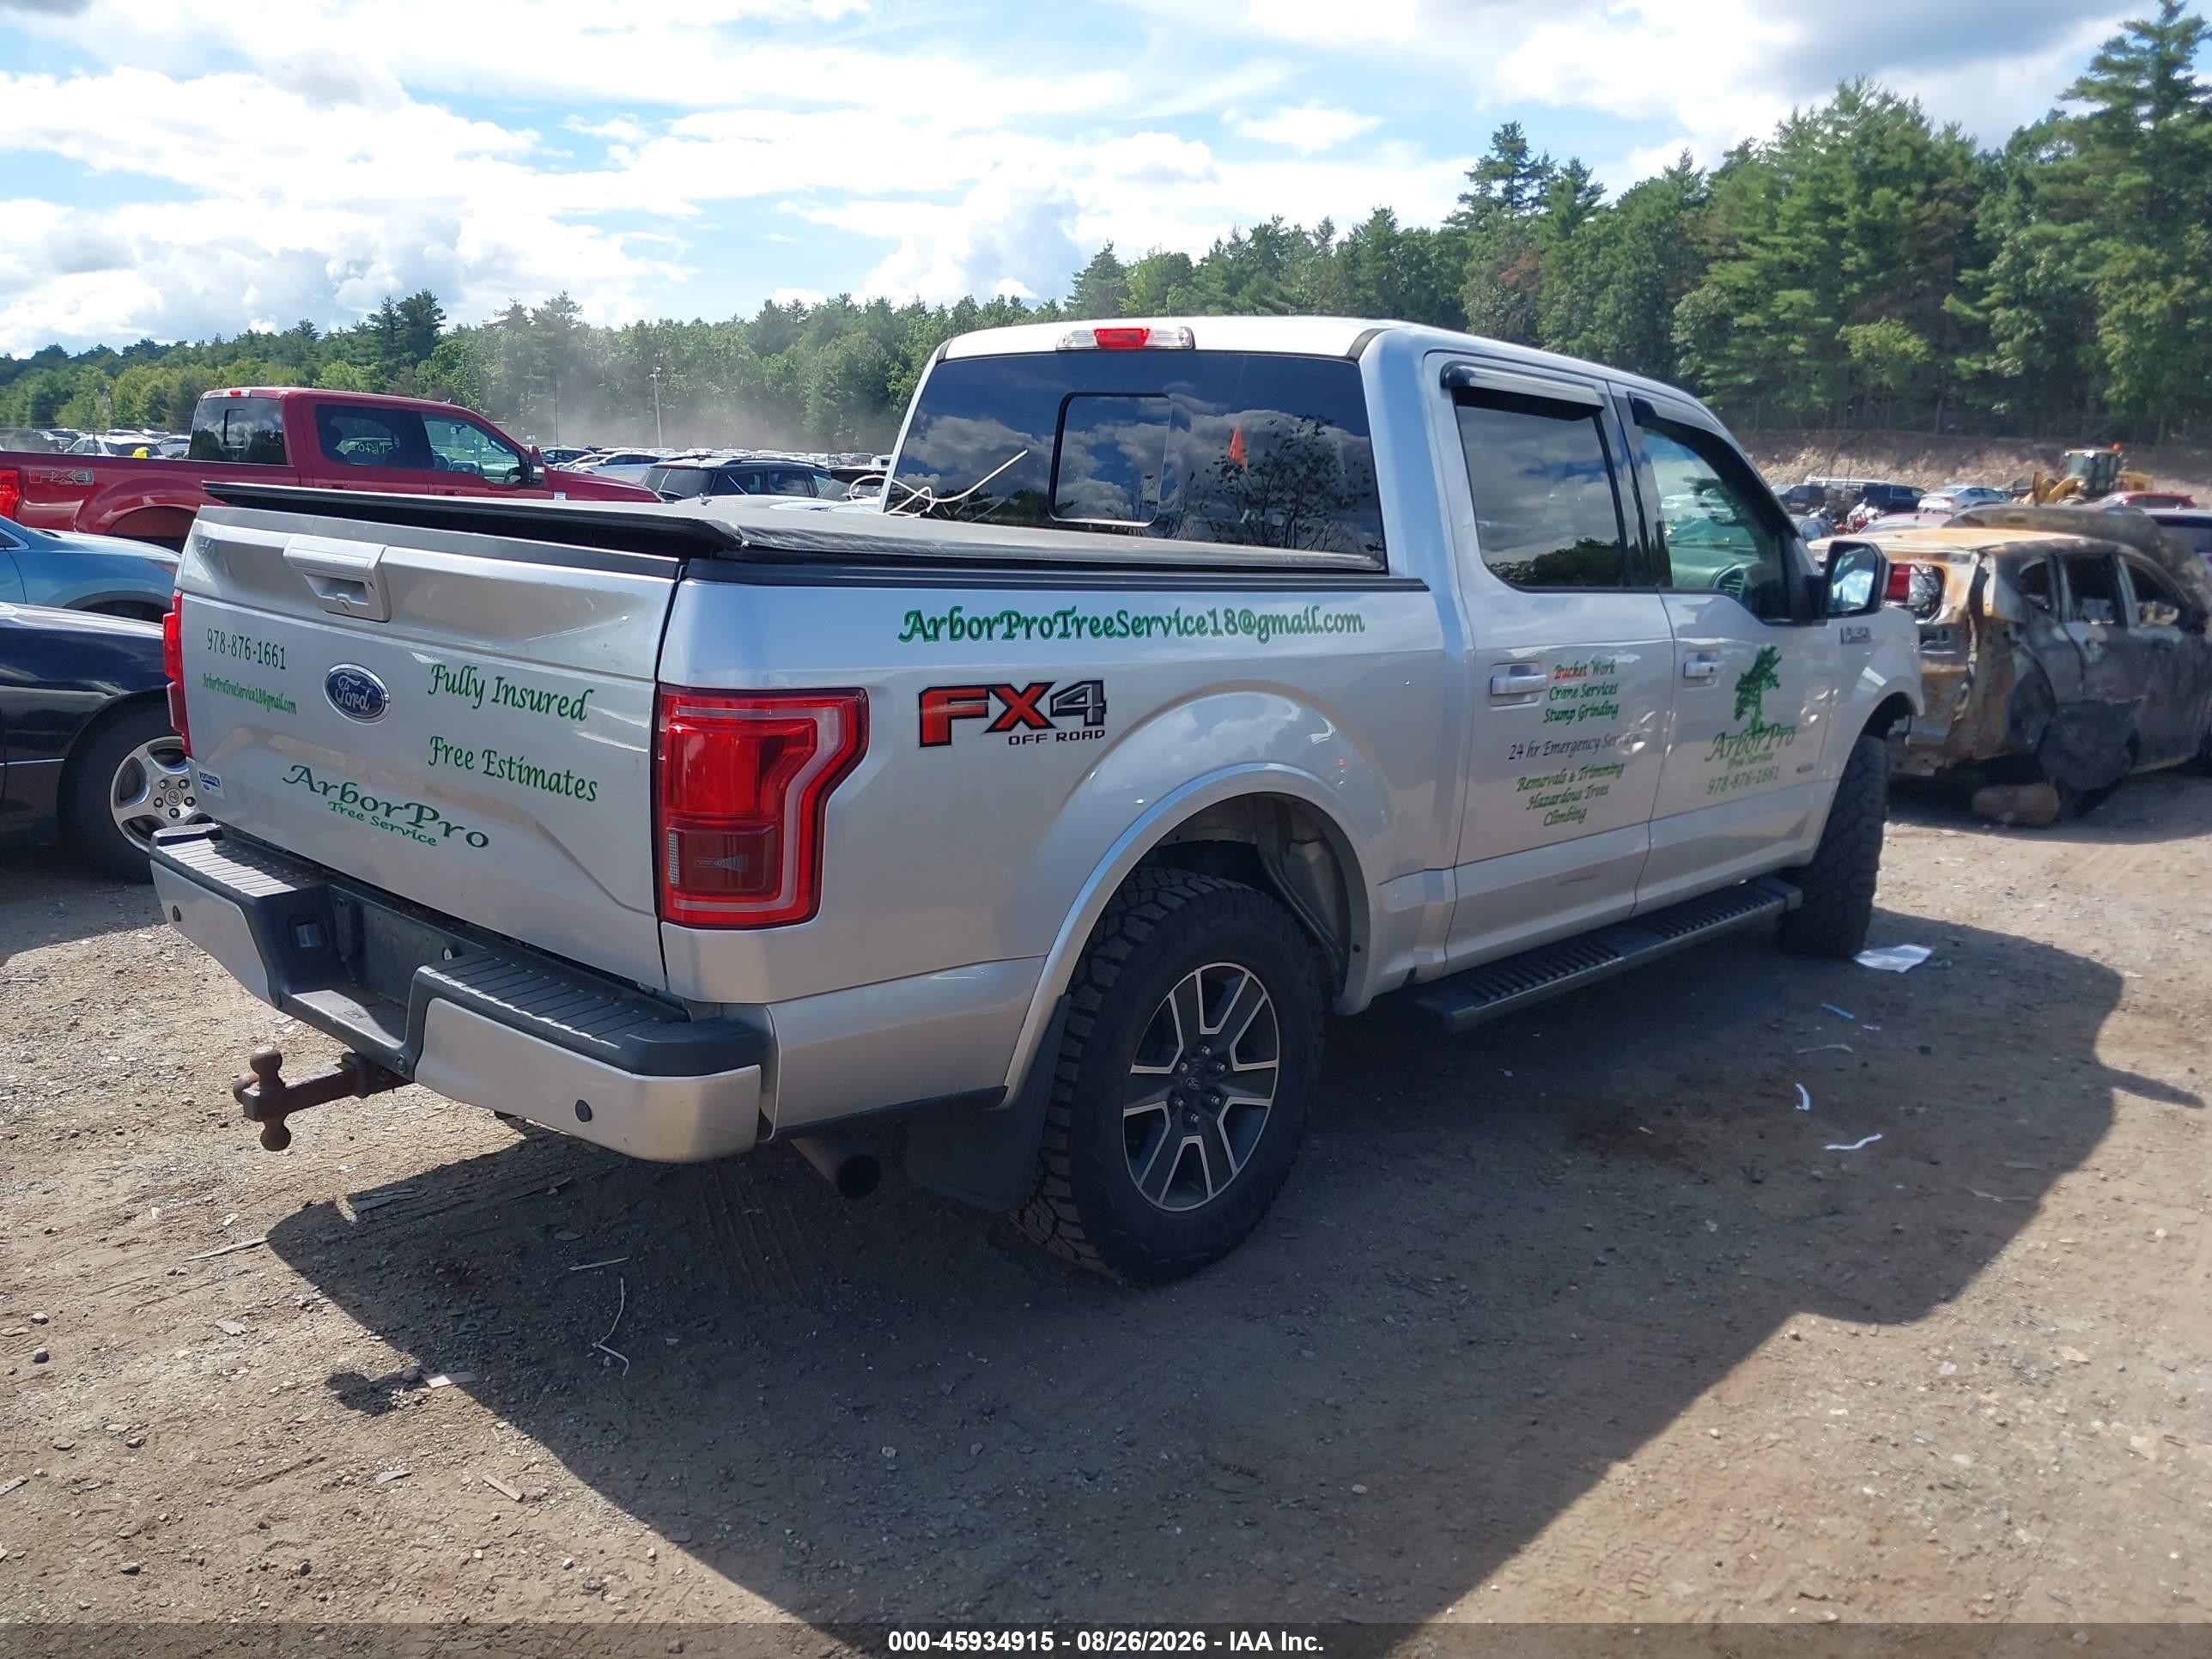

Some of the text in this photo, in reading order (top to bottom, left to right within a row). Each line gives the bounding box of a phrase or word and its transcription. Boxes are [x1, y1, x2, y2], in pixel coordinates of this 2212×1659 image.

[898, 605, 1365, 644] ArborProTreeService18@gmail.com
[207, 628, 286, 670] 978-876-1661
[1553, 659, 1616, 679] Bucket Work
[335, 675, 370, 712] Ford
[428, 664, 595, 720] Fully Insured
[1549, 681, 1619, 701] Crane Services
[918, 680, 1107, 748] FX4
[1543, 700, 1620, 726] Stump Grinding
[1008, 728, 1106, 745] OFF ROAD
[1508, 744, 1523, 760] 24
[1526, 741, 1540, 757] hr
[1543, 737, 1601, 758] Emergency
[1705, 723, 1796, 763] ArborPro
[428, 736, 598, 801] Free Estimates
[1516, 768, 1567, 791] Removals
[282, 764, 489, 848] ArborPro
[328, 800, 438, 847] Tree Service
